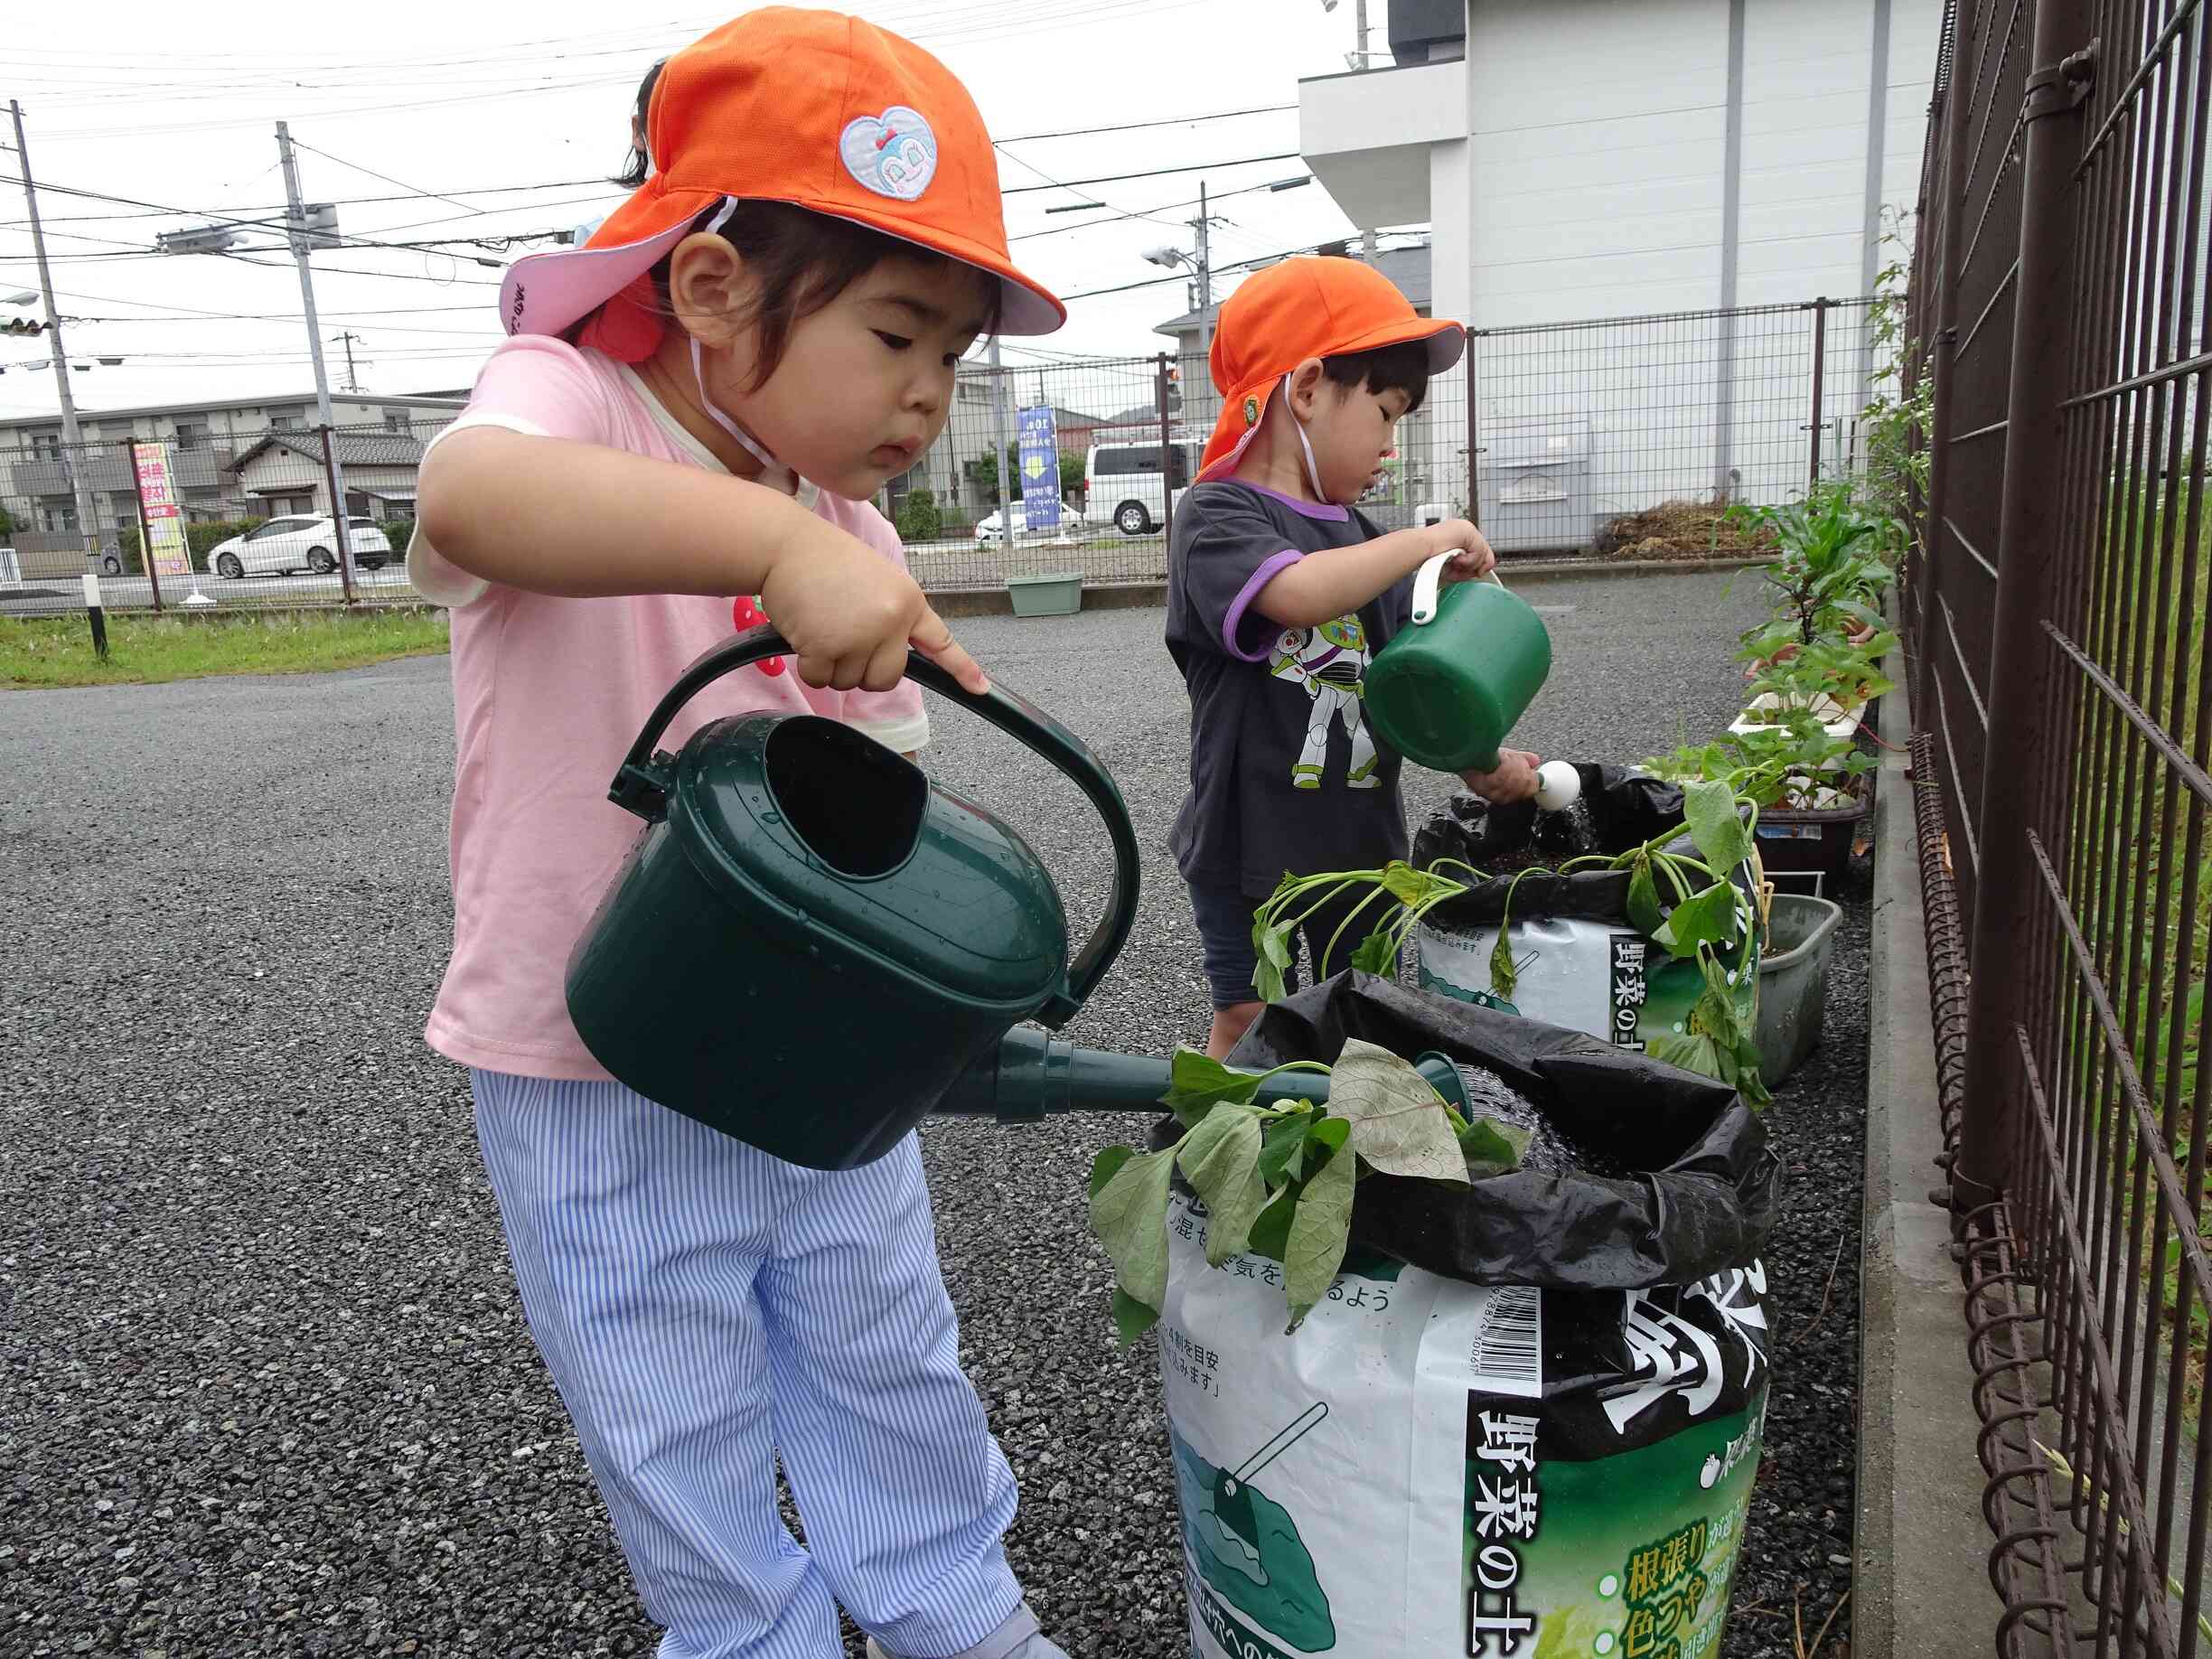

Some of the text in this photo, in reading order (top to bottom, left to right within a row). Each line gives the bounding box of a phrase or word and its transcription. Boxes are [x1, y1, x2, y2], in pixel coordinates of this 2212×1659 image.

[1615, 943, 1646, 1050] 野菜の土
[1474, 1410, 1541, 1654] 野菜の土
